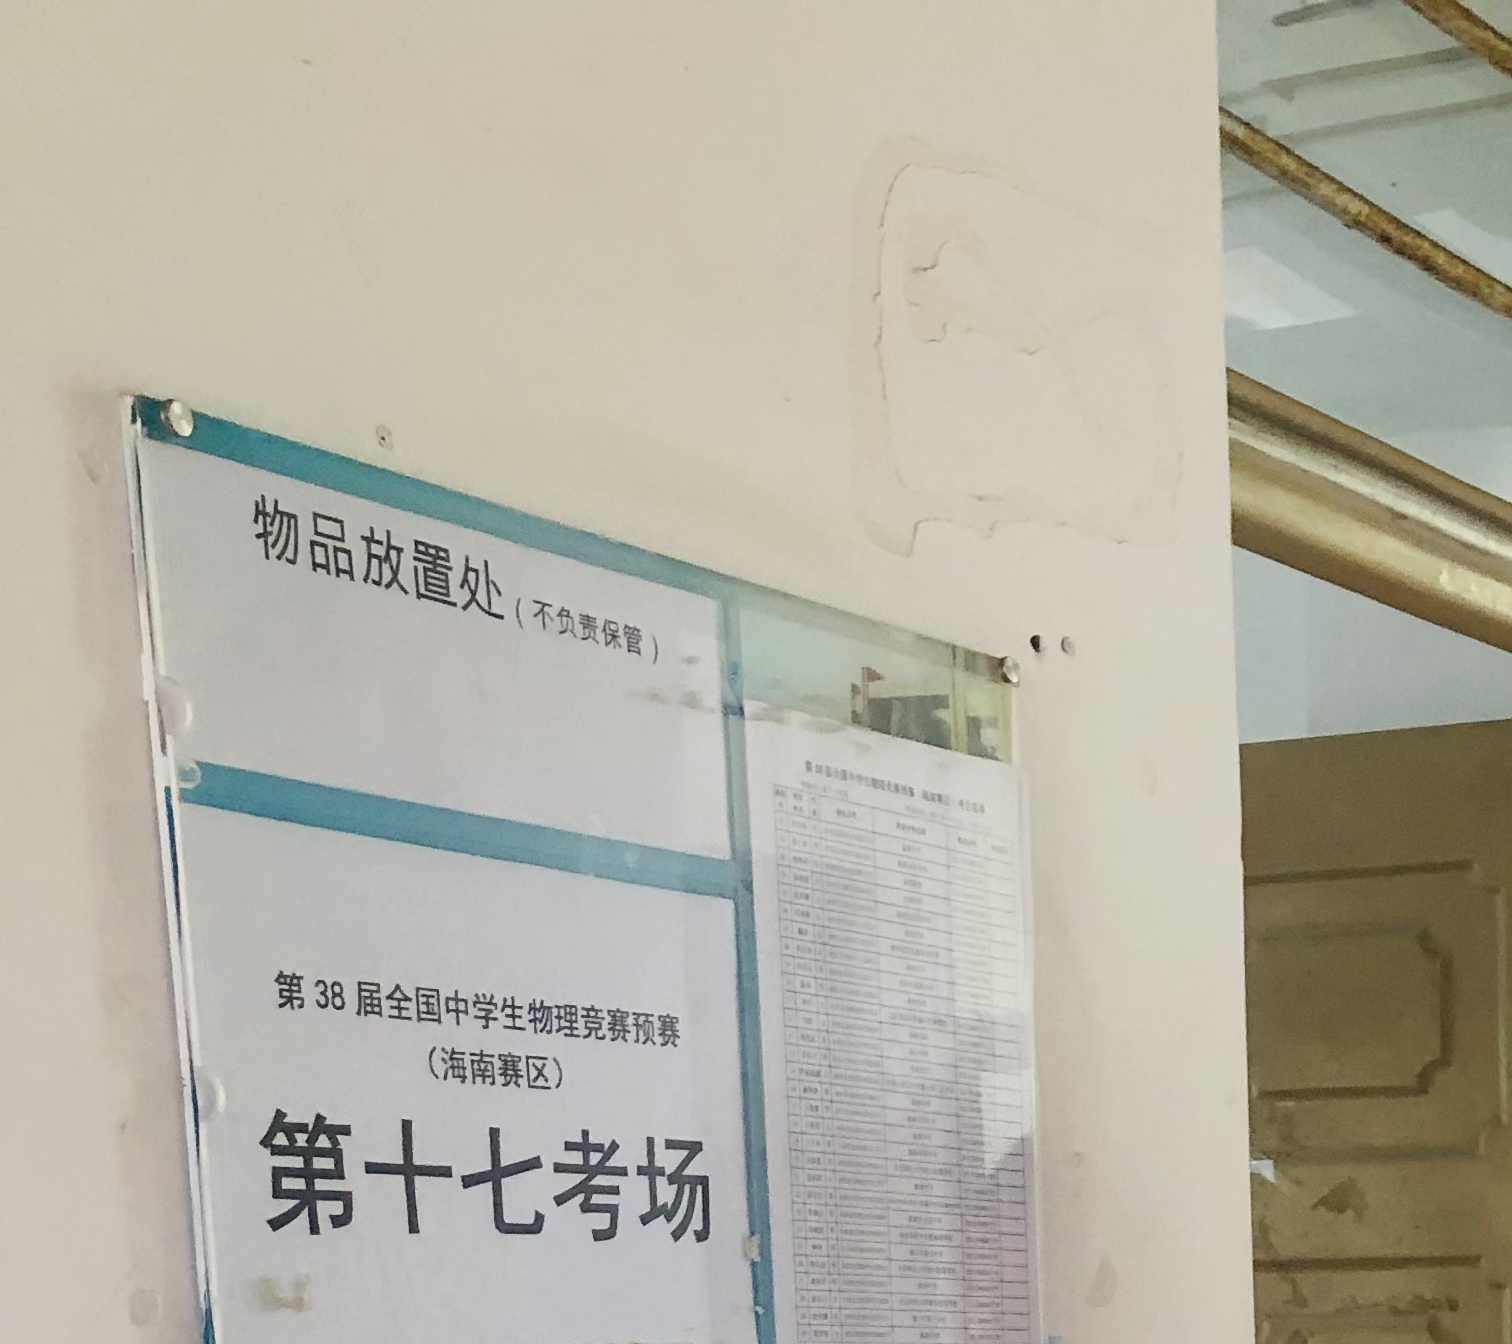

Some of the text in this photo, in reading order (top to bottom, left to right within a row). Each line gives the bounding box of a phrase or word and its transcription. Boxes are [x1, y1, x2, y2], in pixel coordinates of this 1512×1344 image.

[355, 981, 681, 1048] 届全国中学生物理竞赛预赛
[427, 1046, 564, 1090] （海南赛区）
[259, 1108, 711, 1244] 第十七考场
